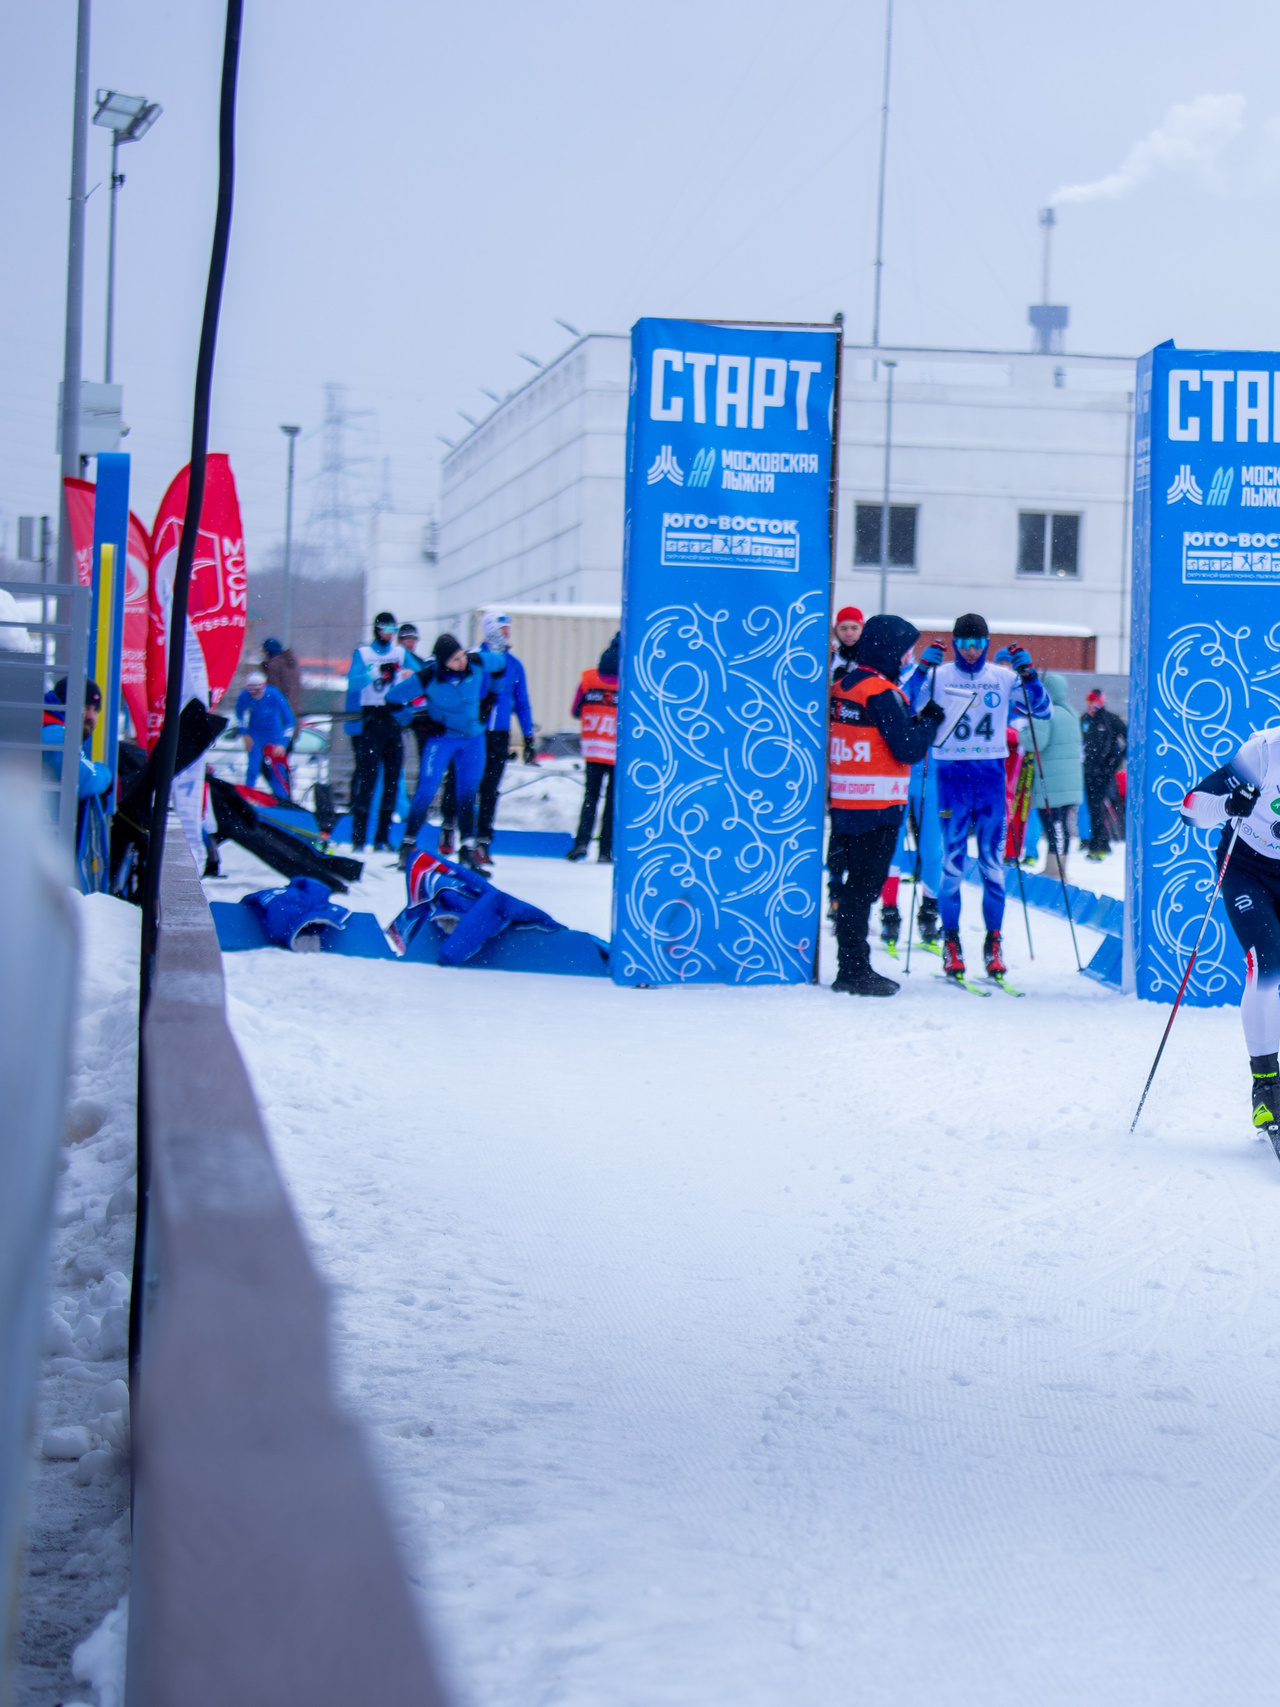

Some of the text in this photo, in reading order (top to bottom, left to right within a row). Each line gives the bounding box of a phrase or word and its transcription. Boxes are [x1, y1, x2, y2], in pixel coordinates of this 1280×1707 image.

[650, 348, 822, 431] СТАРТ
[721, 449, 819, 474] МОСКОВСКАЯ
[720, 470, 775, 493] ЛЫЖНЯ
[663, 513, 799, 535] ЮГО-ВОСТОК
[954, 712, 995, 741] 64
